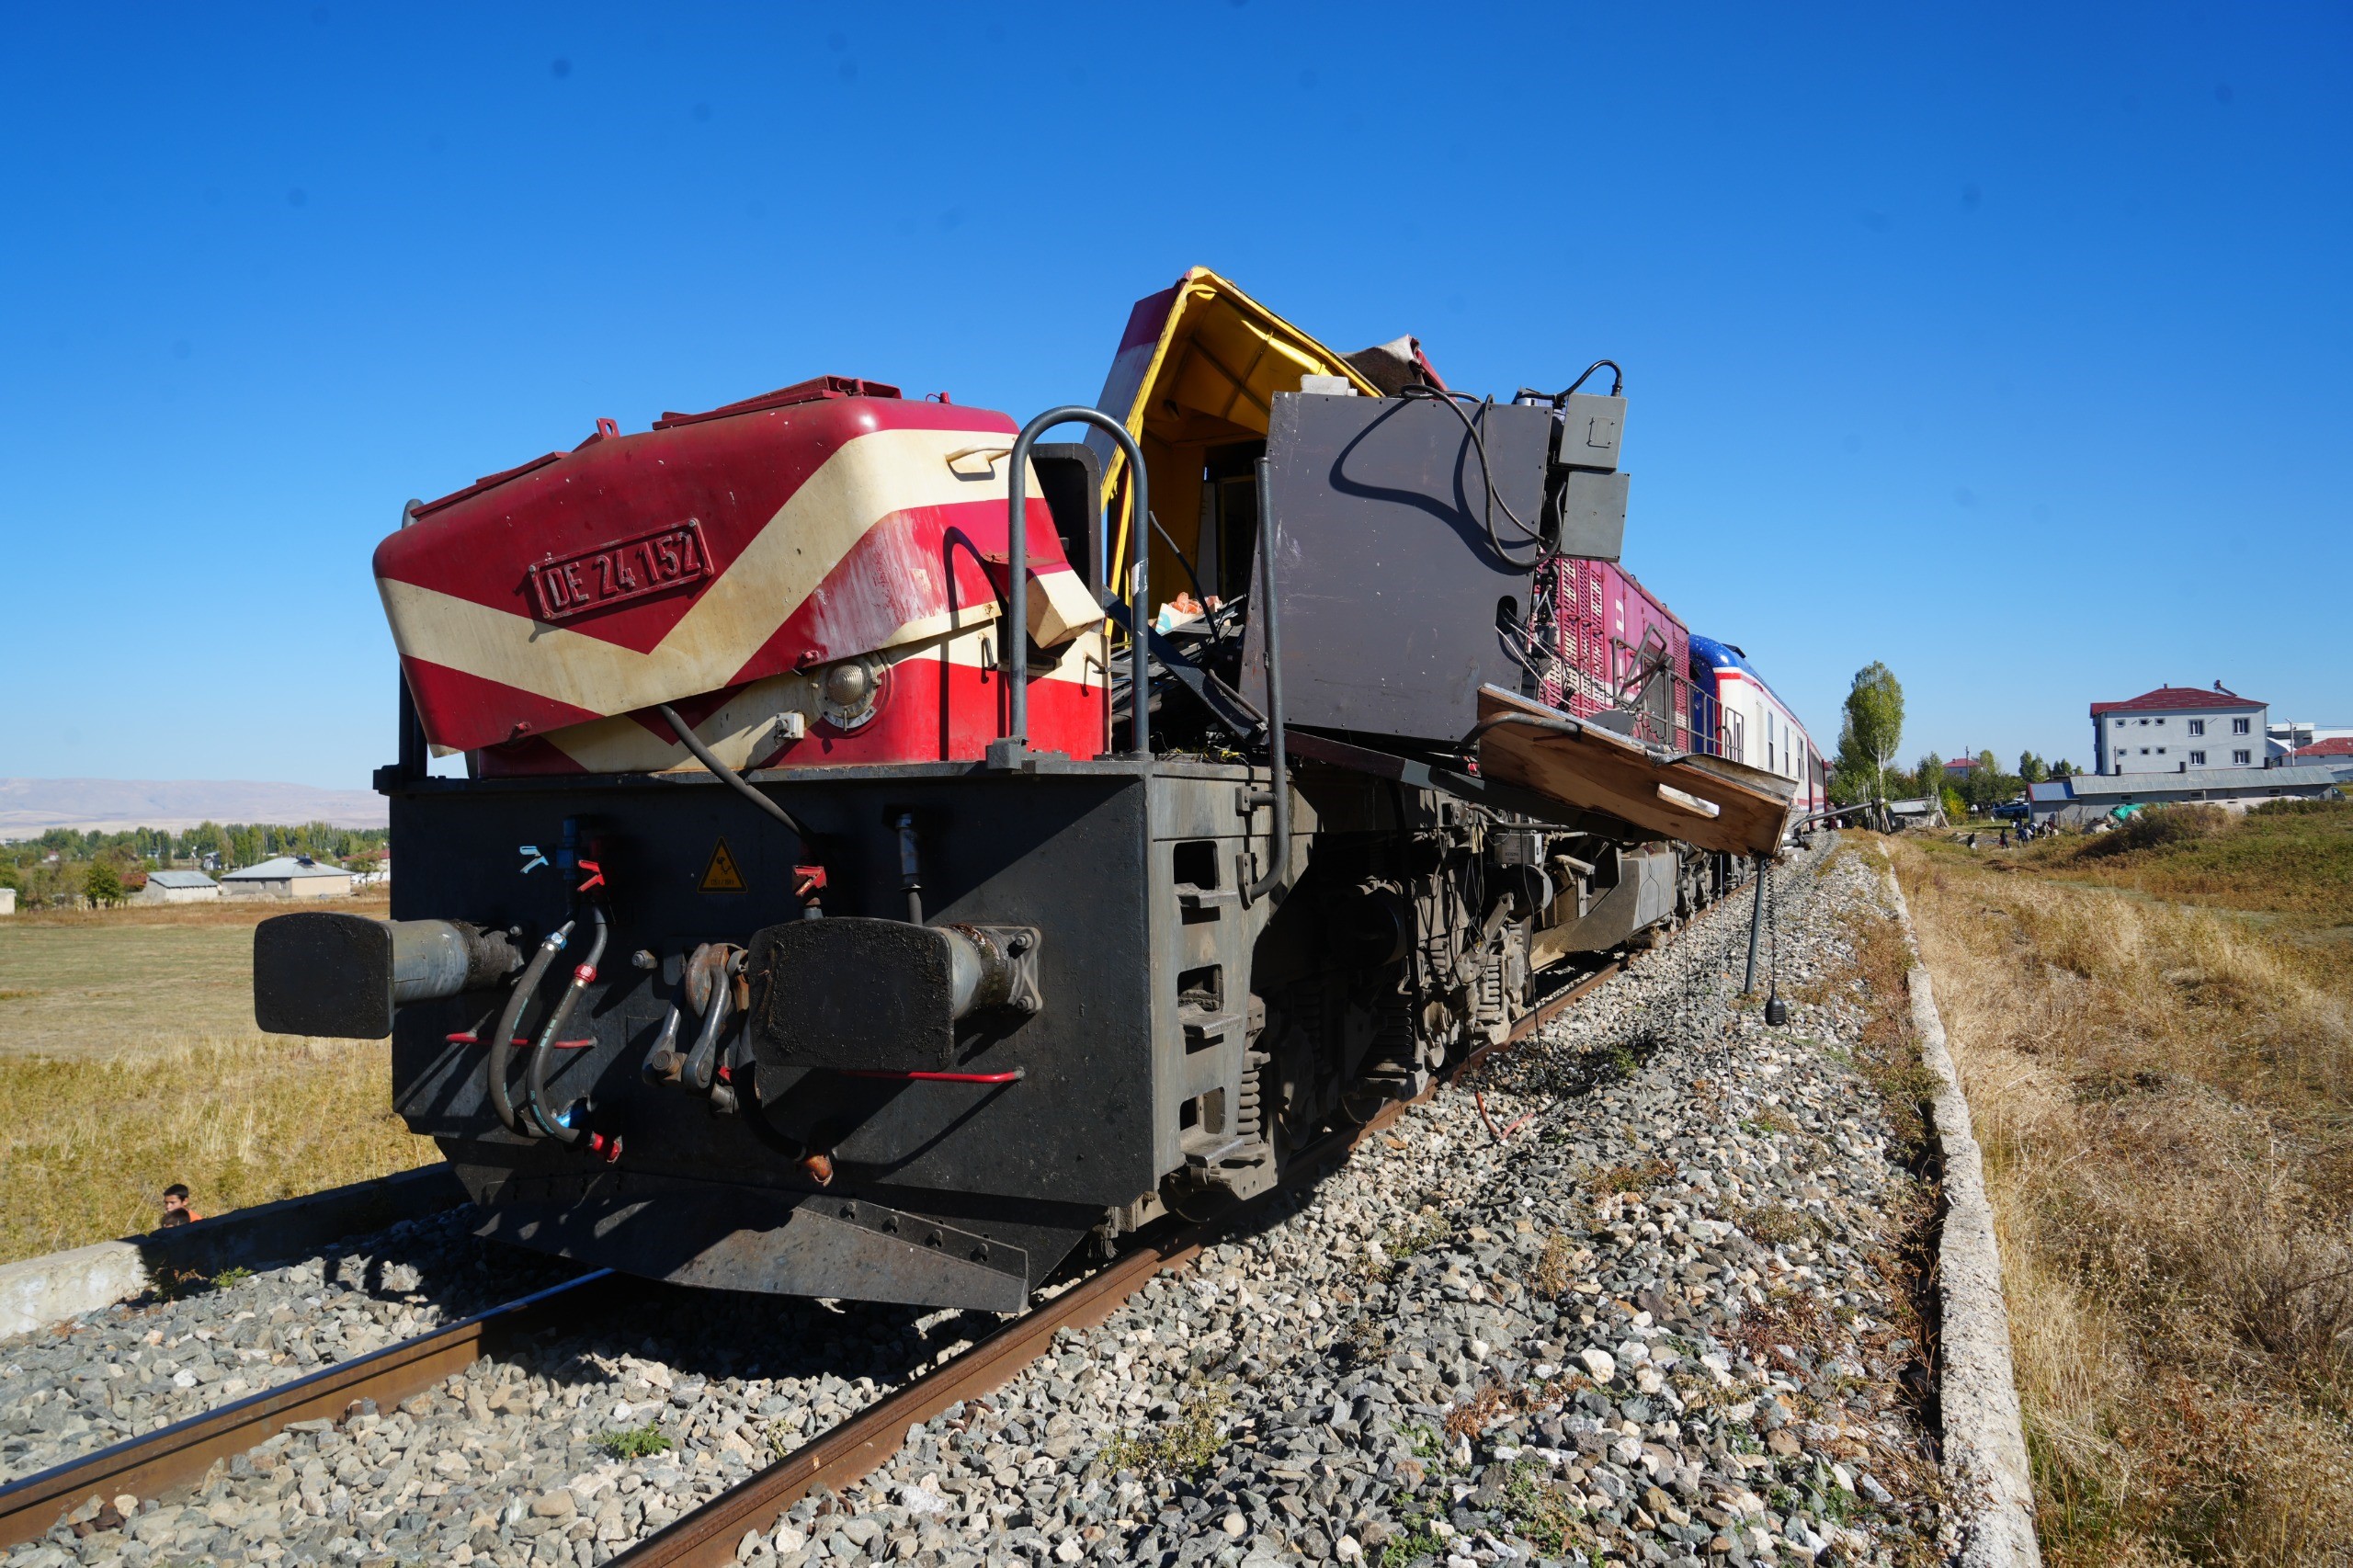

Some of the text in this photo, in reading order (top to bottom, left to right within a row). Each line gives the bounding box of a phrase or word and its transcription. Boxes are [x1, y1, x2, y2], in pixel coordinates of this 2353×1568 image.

[546, 531, 700, 608] DE 24 152
